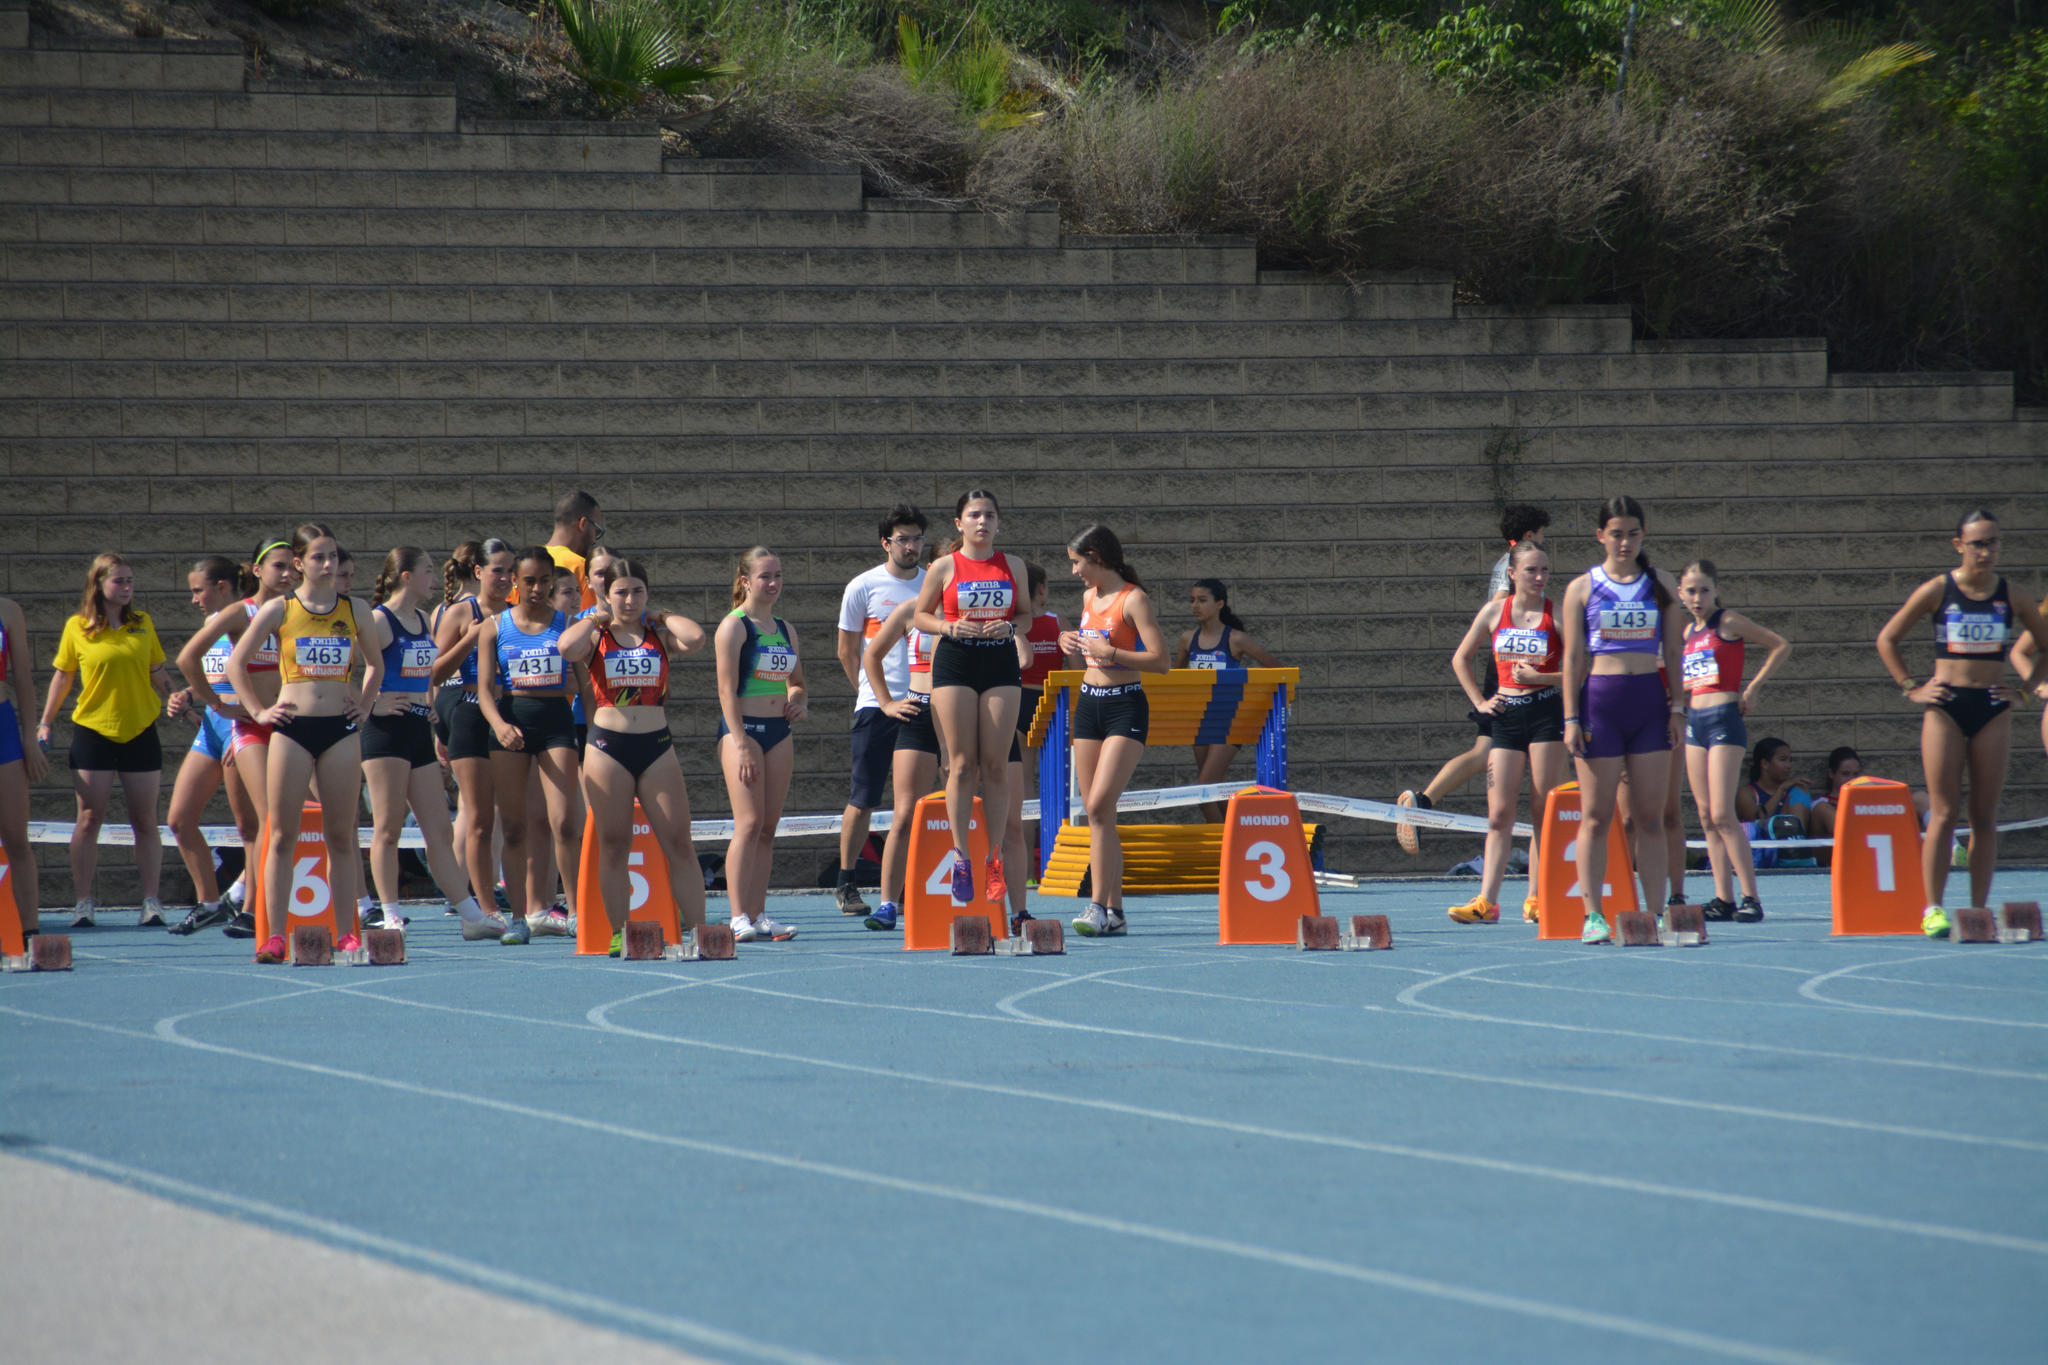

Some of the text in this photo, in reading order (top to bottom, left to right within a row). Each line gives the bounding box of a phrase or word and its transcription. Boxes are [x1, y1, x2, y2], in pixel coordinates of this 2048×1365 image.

[968, 590, 1004, 608] 278
[1611, 612, 1647, 628] 143
[1958, 624, 1994, 641] 402
[1504, 637, 1538, 653] 456
[306, 647, 342, 665] 463
[416, 650, 430, 666] 65
[771, 655, 788, 670] 99
[205, 658, 224, 673] 126
[519, 657, 554, 675] 431
[615, 658, 652, 675] 459
[1090, 686, 1122, 697] NIKE
[1854, 805, 1906, 815] MONDO
[1240, 815, 1290, 826] MONDO
[1244, 841, 1292, 901] 3
[1866, 834, 1896, 892] 1
[288, 857, 331, 917] 6
[925, 849, 967, 908] 4
